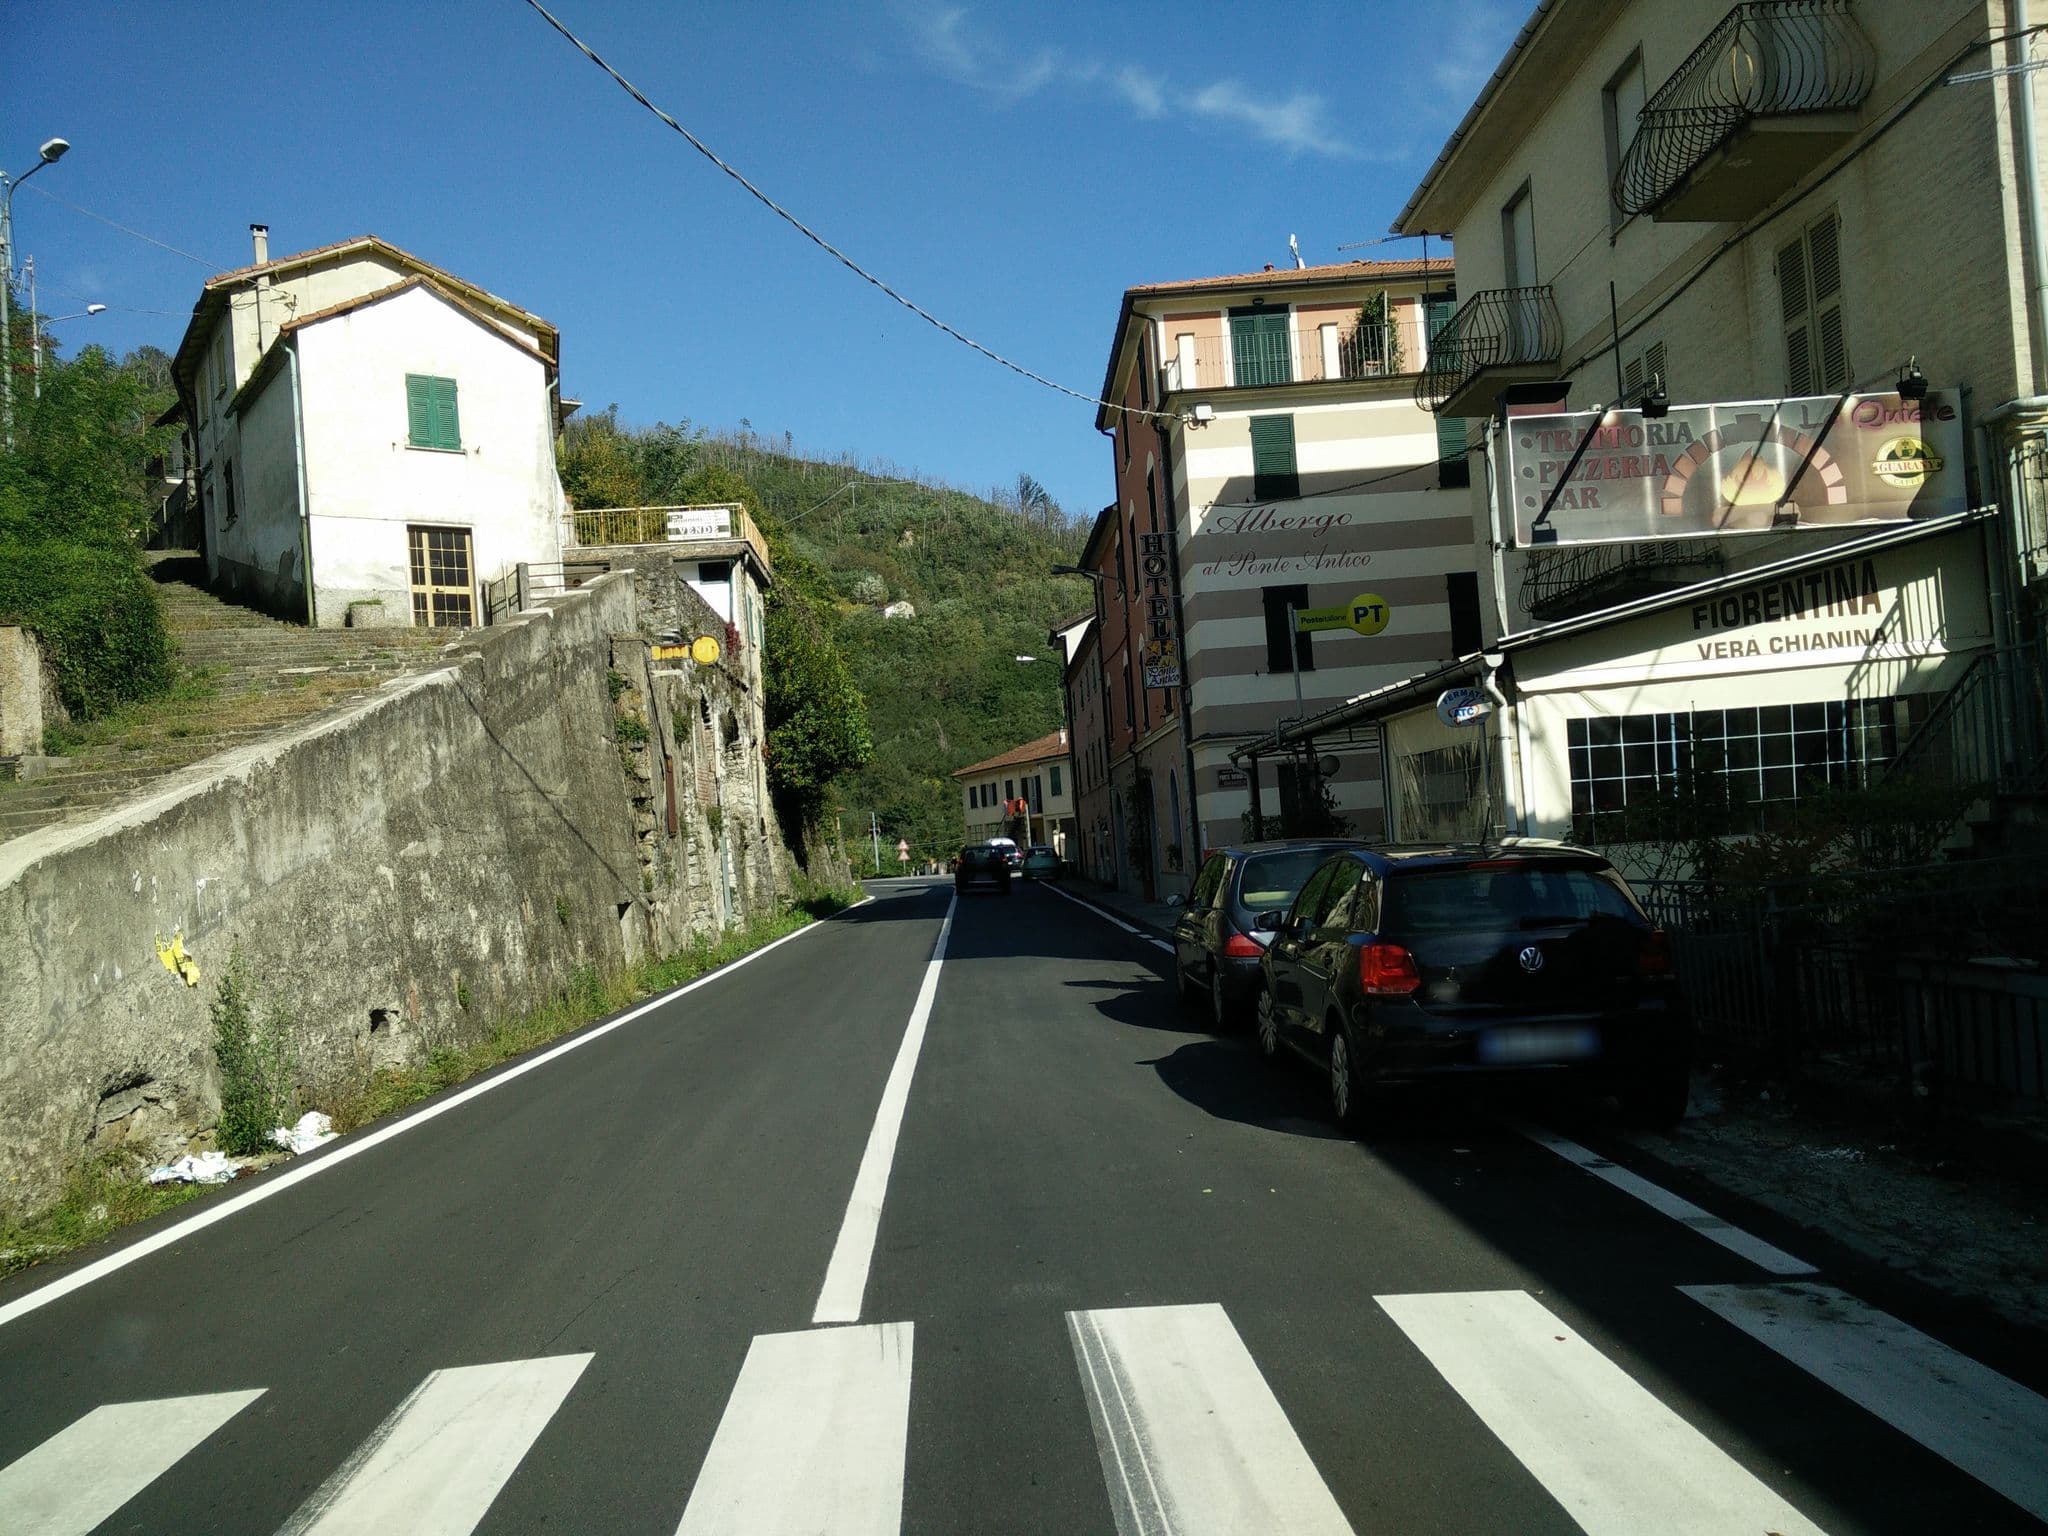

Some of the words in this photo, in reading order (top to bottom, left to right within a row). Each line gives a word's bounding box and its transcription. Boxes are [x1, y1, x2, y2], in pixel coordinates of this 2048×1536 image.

[1536, 421, 1694, 453] TRATTORIA
[1538, 453, 1671, 484] PIZZERIA
[1207, 508, 1353, 538] Albergo
[1202, 556, 1221, 576] al
[1228, 550, 1290, 577] Ponte
[1296, 544, 1373, 571] Antico
[1140, 534, 1171, 640] HOTEL
[1692, 559, 1882, 631] FIORENTINA
[1353, 604, 1384, 625] PT
[1697, 638, 1761, 661] VERA
[1769, 627, 1887, 655] CHIANINA
[1454, 707, 1474, 717] ATC
